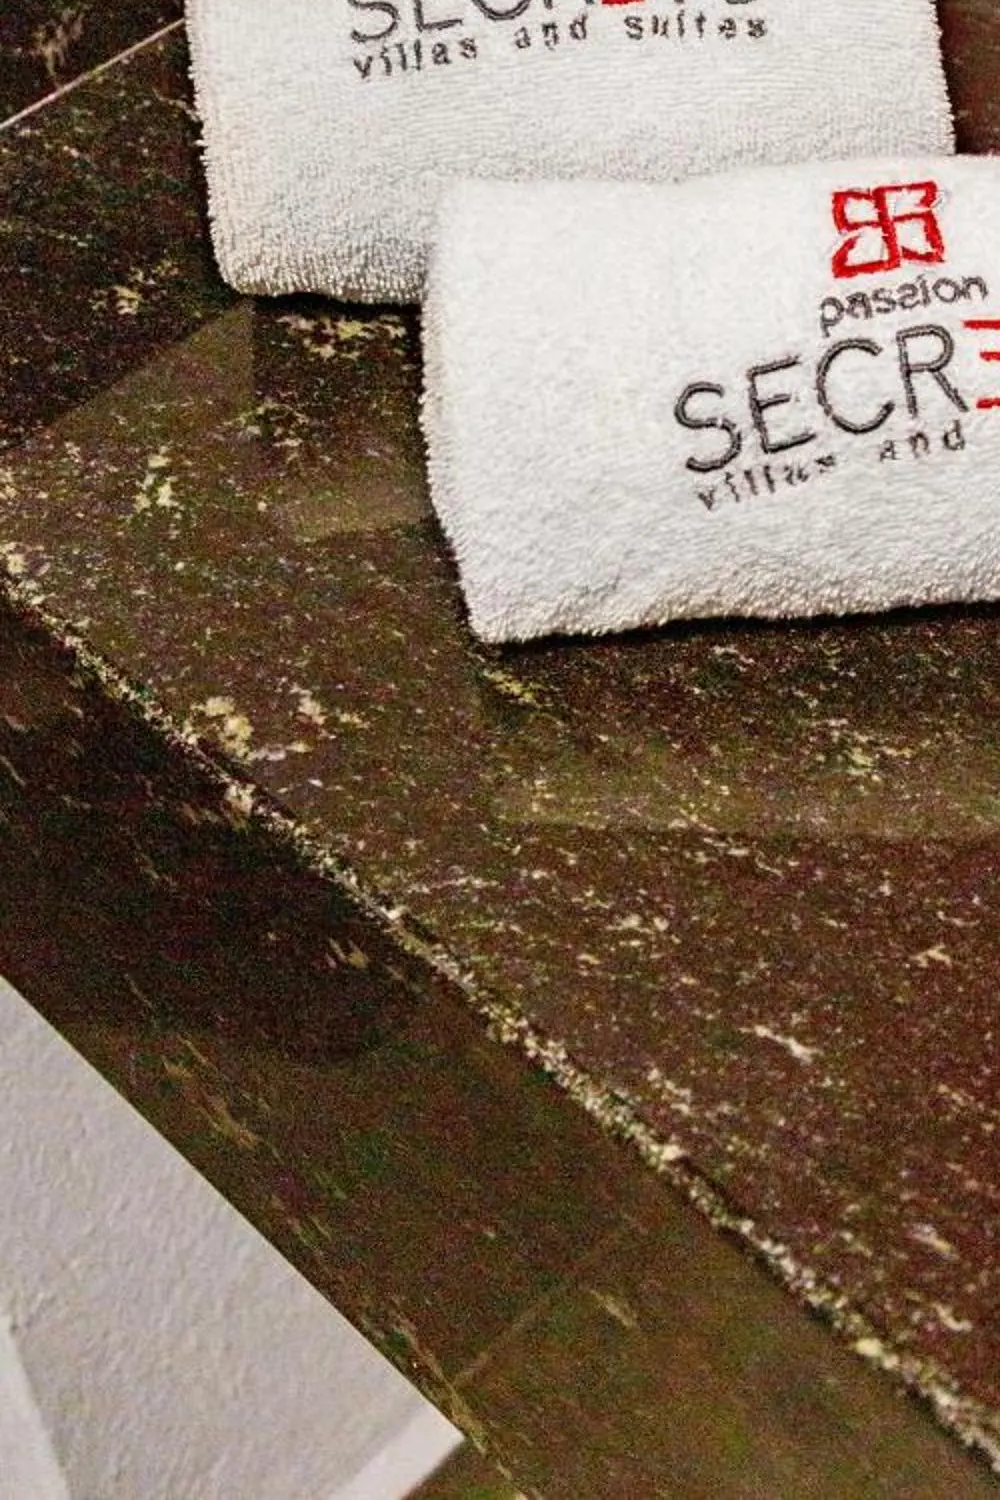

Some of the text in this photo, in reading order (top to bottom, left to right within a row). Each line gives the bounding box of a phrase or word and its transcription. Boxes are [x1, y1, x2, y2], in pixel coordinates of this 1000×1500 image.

[354, 11, 767, 80] villas and suites
[878, 419, 966, 462] and
